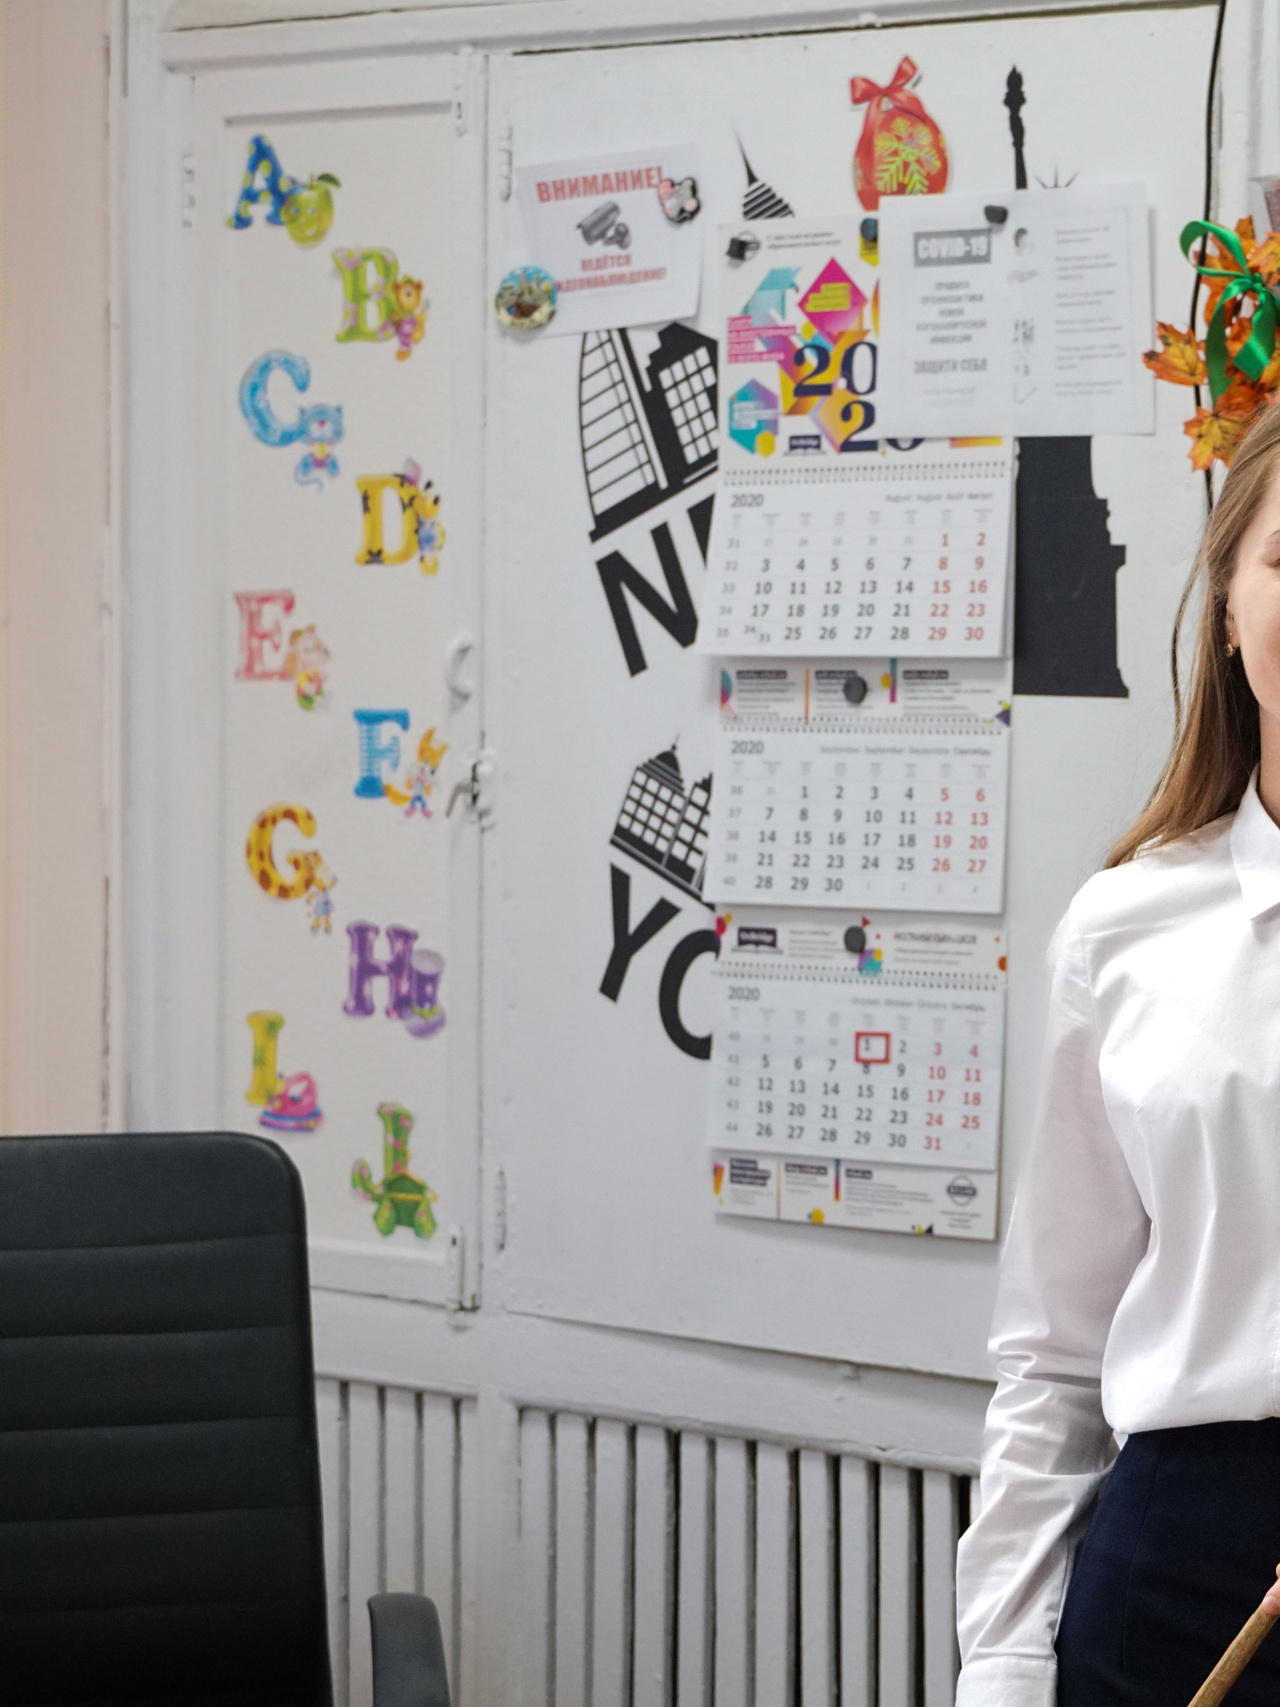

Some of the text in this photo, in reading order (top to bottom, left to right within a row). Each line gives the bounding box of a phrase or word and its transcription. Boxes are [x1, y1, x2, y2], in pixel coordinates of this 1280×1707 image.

[228, 134, 292, 229] A
[917, 235, 988, 260] COVID-19
[332, 248, 401, 344] B
[793, 341, 879, 398] 20
[238, 350, 311, 448] C
[731, 493, 764, 508] 2020
[356, 473, 422, 566] D
[941, 533, 949, 547] 1
[976, 532, 986, 546] 2
[762, 558, 770, 572] 3
[796, 558, 805, 571] 4
[831, 557, 839, 572] 5
[865, 557, 875, 571] 6
[903, 557, 912, 571] 7
[938, 556, 948, 571] 8
[975, 556, 985, 570] 9
[755, 581, 773, 595] 10
[790, 581, 807, 595] 11
[825, 581, 842, 594] 12
[860, 580, 878, 594] 13
[896, 580, 914, 594] 14
[933, 580, 951, 594] 15
[969, 579, 988, 594] 16
[752, 604, 770, 617] 17
[787, 604, 805, 618] 18
[822, 604, 840, 617] 19
[857, 603, 875, 617] 20
[893, 603, 910, 617] 21
[930, 603, 949, 617] 22
[966, 603, 986, 617] 23
[233, 590, 295, 680] E
[784, 627, 802, 640] 25
[819, 627, 837, 640] 26
[854, 626, 872, 640] 27
[890, 626, 910, 640] 28
[928, 626, 947, 640] 29
[964, 626, 984, 641] 30
[353, 708, 411, 799] F
[731, 740, 764, 754] 2020
[801, 785, 808, 799] 1
[835, 785, 844, 799] 2
[870, 786, 879, 800] 3
[905, 786, 914, 800] 4
[941, 787, 950, 802] 5
[976, 788, 985, 803] 6
[765, 806, 774, 820] 7
[799, 807, 809, 822] 8
[833, 808, 843, 822] 9
[865, 809, 883, 824] 10
[900, 810, 916, 824] 11
[935, 810, 953, 826] 12
[971, 811, 989, 826] 13
[759, 830, 776, 843] 14
[794, 830, 812, 845] 15
[828, 831, 846, 845] 16
[864, 833, 881, 846] 17
[899, 833, 916, 848] 18
[934, 834, 952, 849] 19
[969, 835, 988, 850] 20
[246, 804, 317, 900] G
[757, 852, 774, 867] 21
[792, 853, 810, 868] 22
[826, 854, 844, 869] 23
[861, 855, 879, 870] 24
[897, 856, 915, 871] 25
[932, 857, 951, 872] 26
[968, 858, 986, 873] 27
[755, 875, 773, 889] 28
[790, 876, 809, 891] 29
[824, 877, 843, 892] 30
[343, 921, 419, 1019] H
[728, 985, 760, 1001] 2020
[864, 1038, 870, 1052] 1
[899, 1040, 906, 1054] 2
[934, 1042, 942, 1056] 3
[970, 1044, 978, 1058] 4
[762, 1054, 769, 1068] 5
[794, 1056, 803, 1070] 6
[828, 1058, 836, 1072] 7
[862, 1062, 871, 1075] 8
[897, 1063, 906, 1077] 9
[929, 1066, 946, 1080] 10
[965, 1068, 981, 1082] 11
[758, 1077, 774, 1091] 12
[790, 1079, 806, 1094] 13
[822, 1082, 839, 1095] 14
[858, 1084, 874, 1099] 15
[892, 1086, 910, 1101] 16
[928, 1089, 945, 1103] 17
[963, 1092, 982, 1106] 18
[758, 1100, 773, 1114] 19
[788, 1102, 806, 1116] 20
[821, 1104, 837, 1119] 21
[856, 1107, 873, 1122] 22
[890, 1110, 908, 1124] 23
[926, 1112, 944, 1126] 24
[961, 1114, 980, 1130] 25
[756, 1122, 773, 1137] 26
[787, 1125, 805, 1139] 27
[820, 1128, 838, 1142] 28
[854, 1130, 871, 1144] 29
[888, 1133, 907, 1147] 30
[924, 1136, 941, 1150] 31
